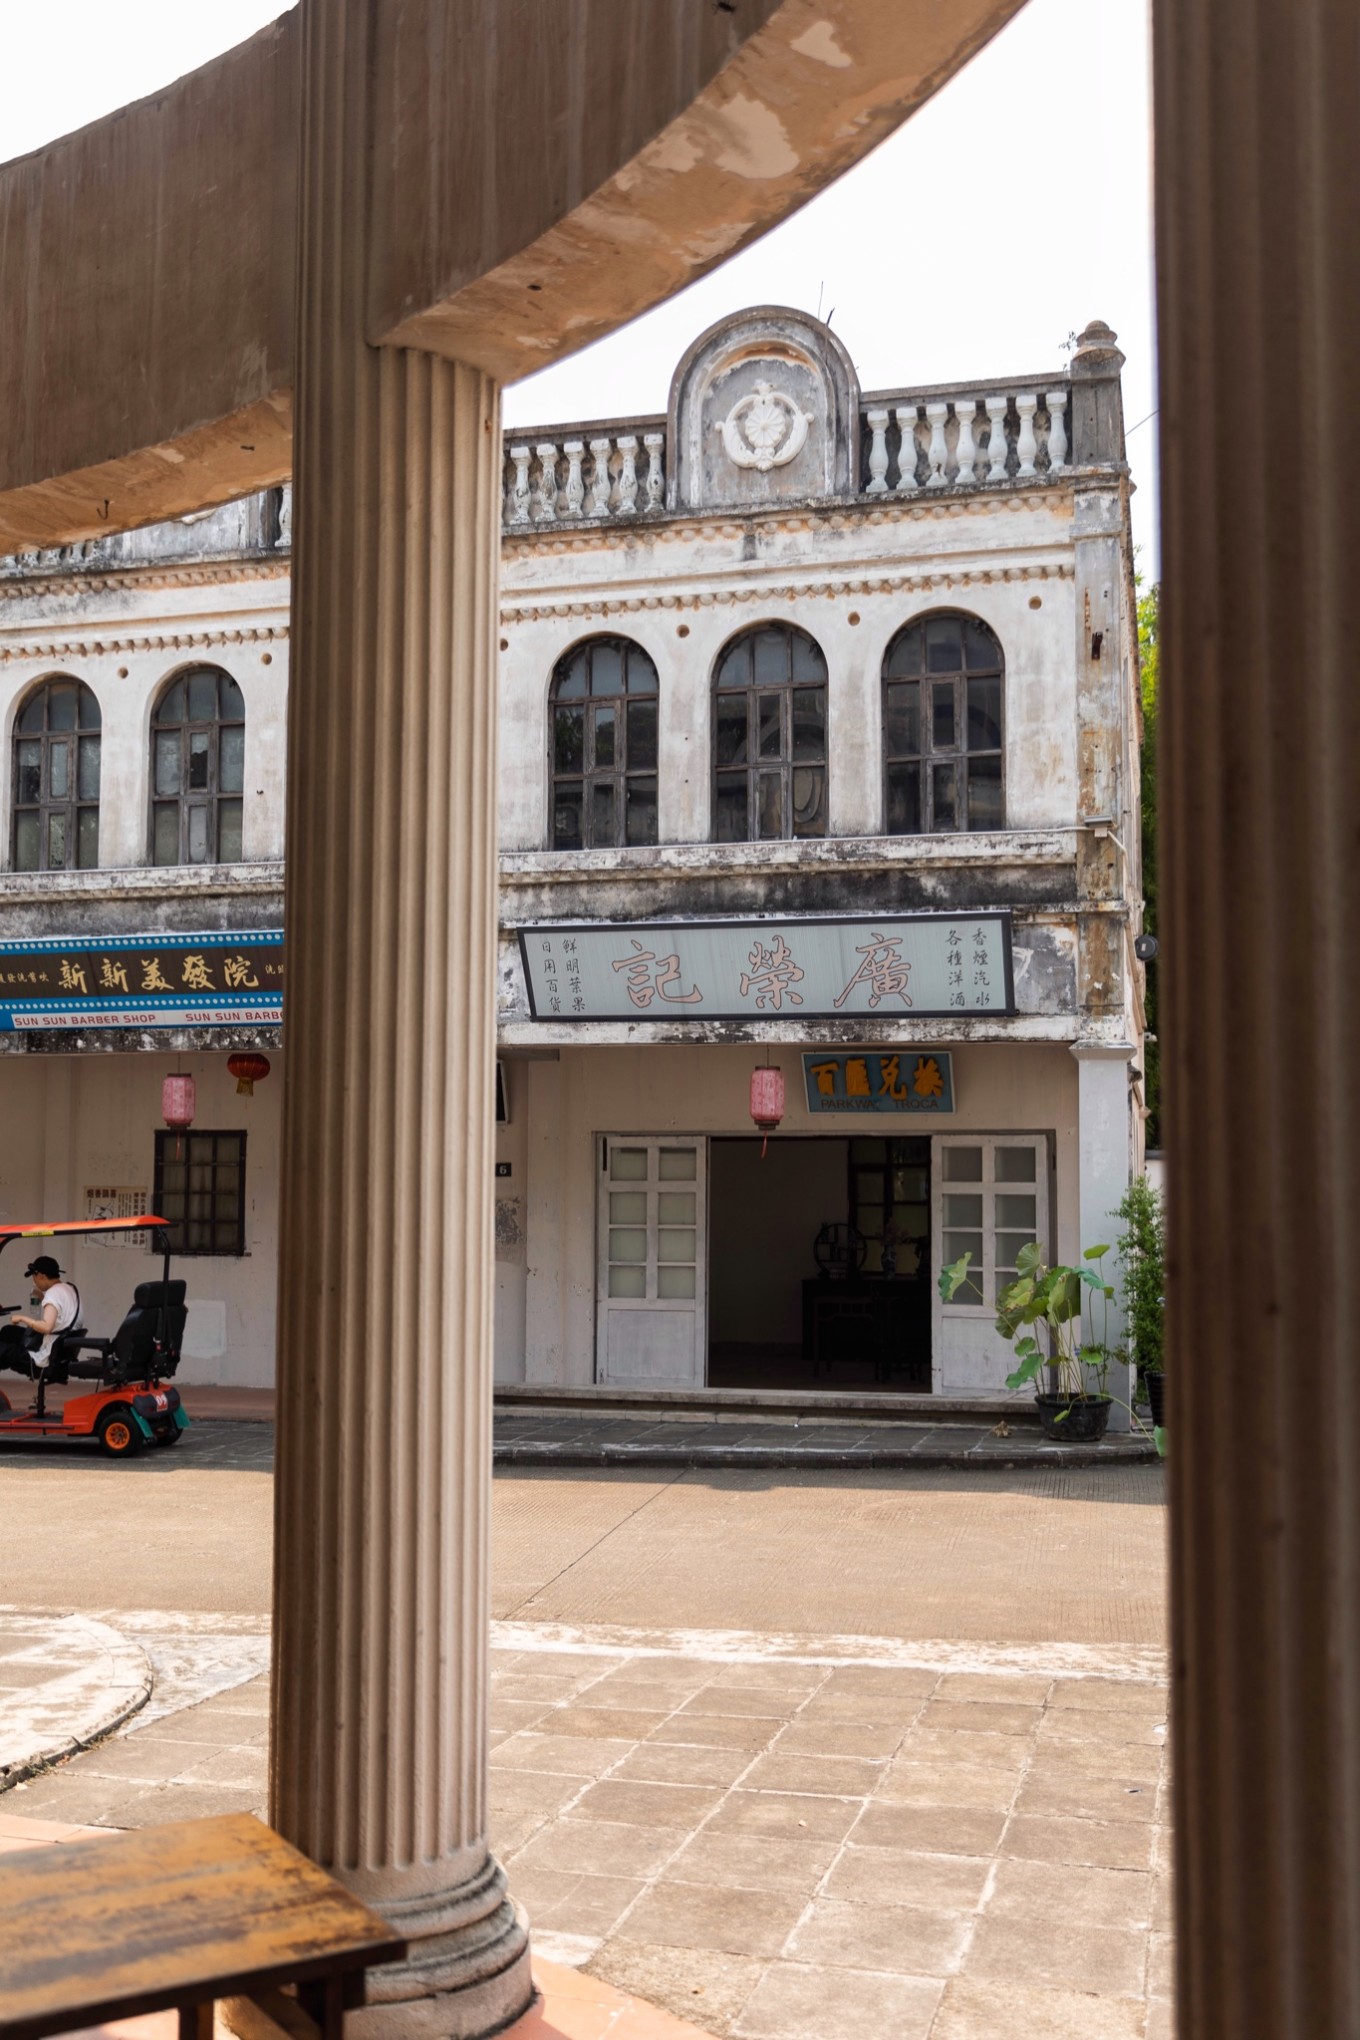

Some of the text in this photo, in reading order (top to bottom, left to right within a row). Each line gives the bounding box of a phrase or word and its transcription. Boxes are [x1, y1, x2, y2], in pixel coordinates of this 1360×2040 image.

[58, 954, 260, 994] 新新美發院
[14, 1014, 156, 1026] SUN SUN BARBER SHOP
[185, 1011, 284, 1022] SUN SUN BARB
[894, 1098, 939, 1109] TROCA
[499, 1165, 507, 1175] 6
